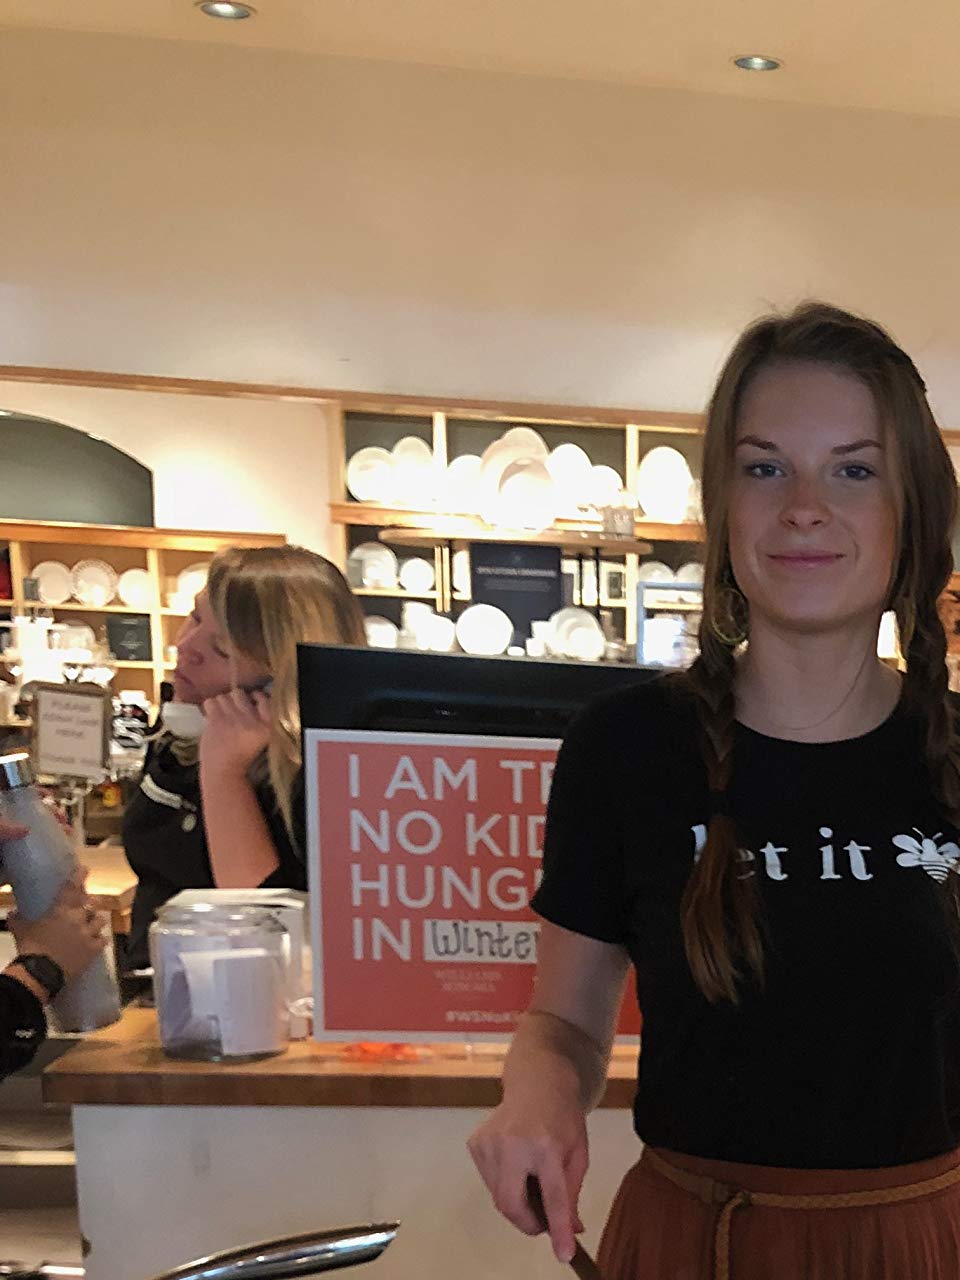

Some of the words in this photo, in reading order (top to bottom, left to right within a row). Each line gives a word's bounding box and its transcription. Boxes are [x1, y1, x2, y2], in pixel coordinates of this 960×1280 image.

[349, 753, 361, 799] I
[384, 755, 478, 801] AM
[350, 809, 443, 855] NO
[818, 825, 874, 881] it
[351, 863, 545, 912] HUNG
[352, 917, 411, 962] IN
[430, 920, 540, 960] Winte
